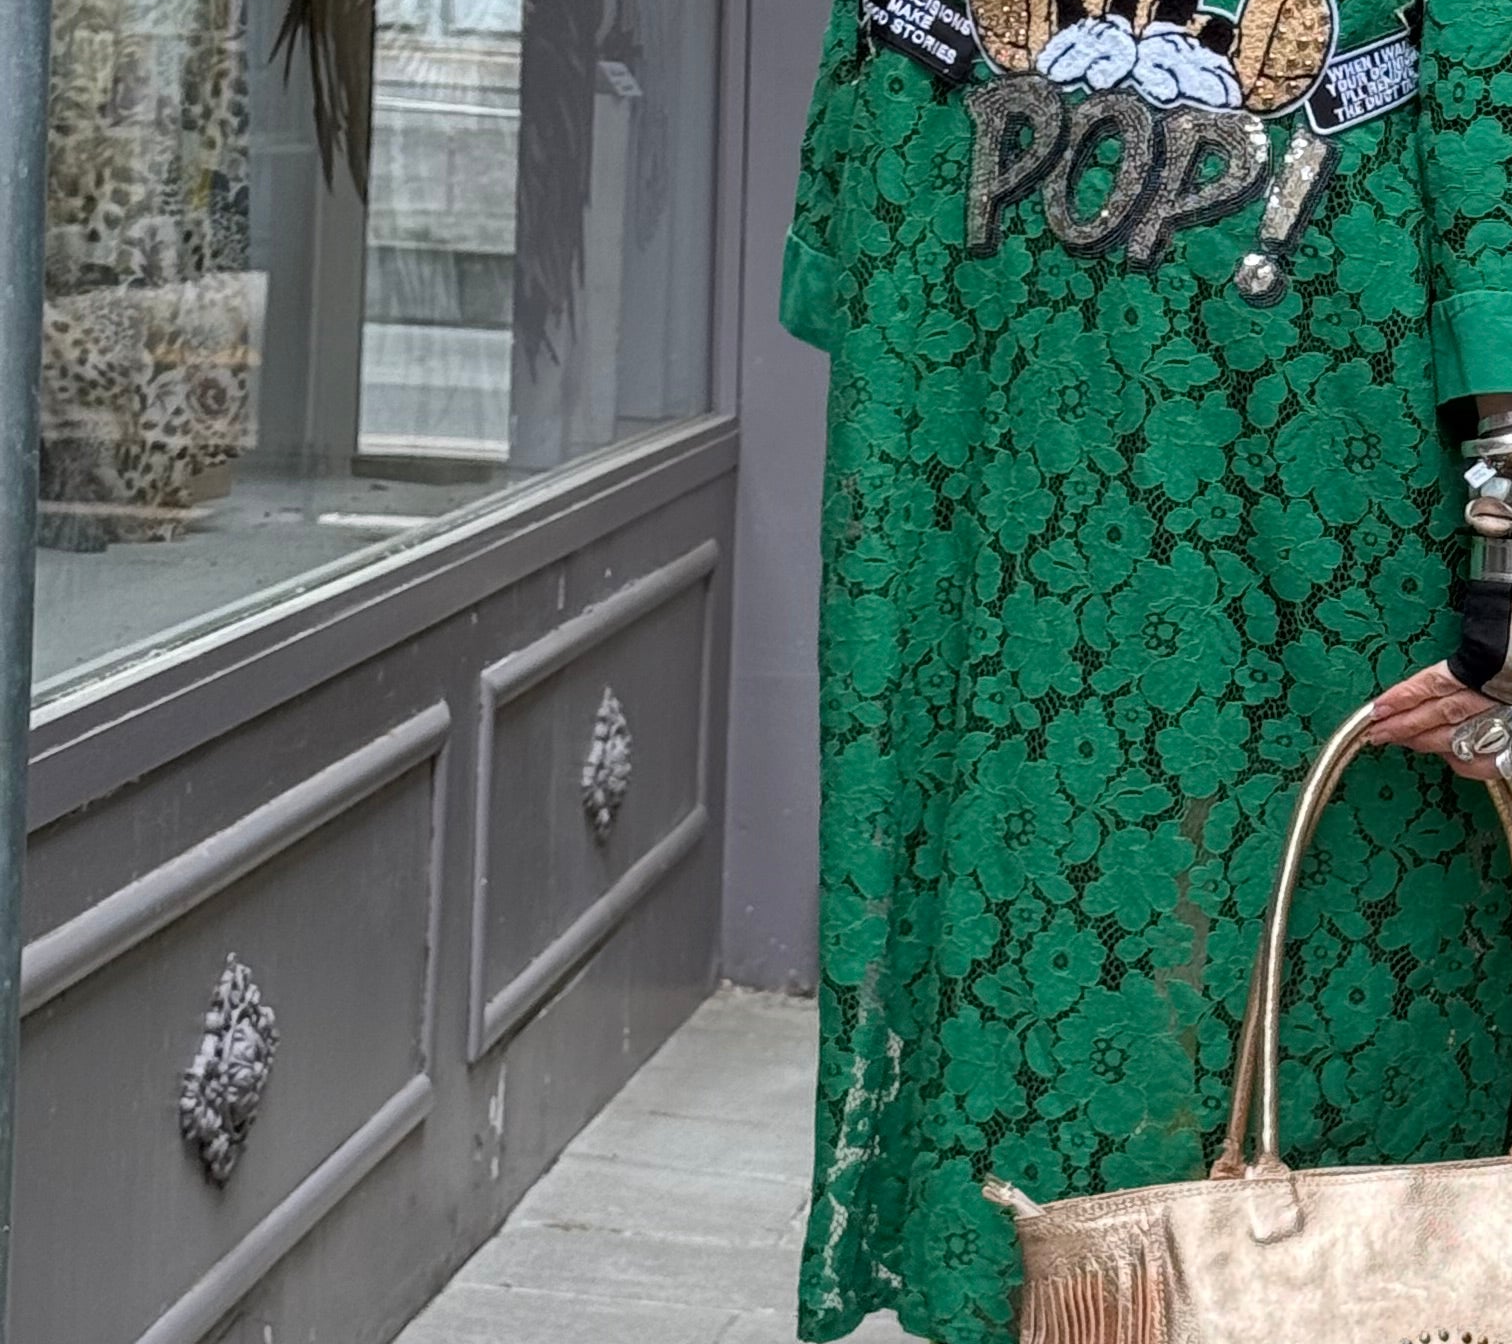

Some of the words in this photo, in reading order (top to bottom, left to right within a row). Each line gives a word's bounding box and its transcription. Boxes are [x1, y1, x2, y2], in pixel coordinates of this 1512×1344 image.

[889, 18, 957, 64] STORIES
[1326, 55, 1372, 82] WHEN
[1373, 51, 1381, 67] I
[1325, 72, 1368, 97] YOUR
[1333, 100, 1365, 123] THE
[966, 71, 1341, 308] POP!
